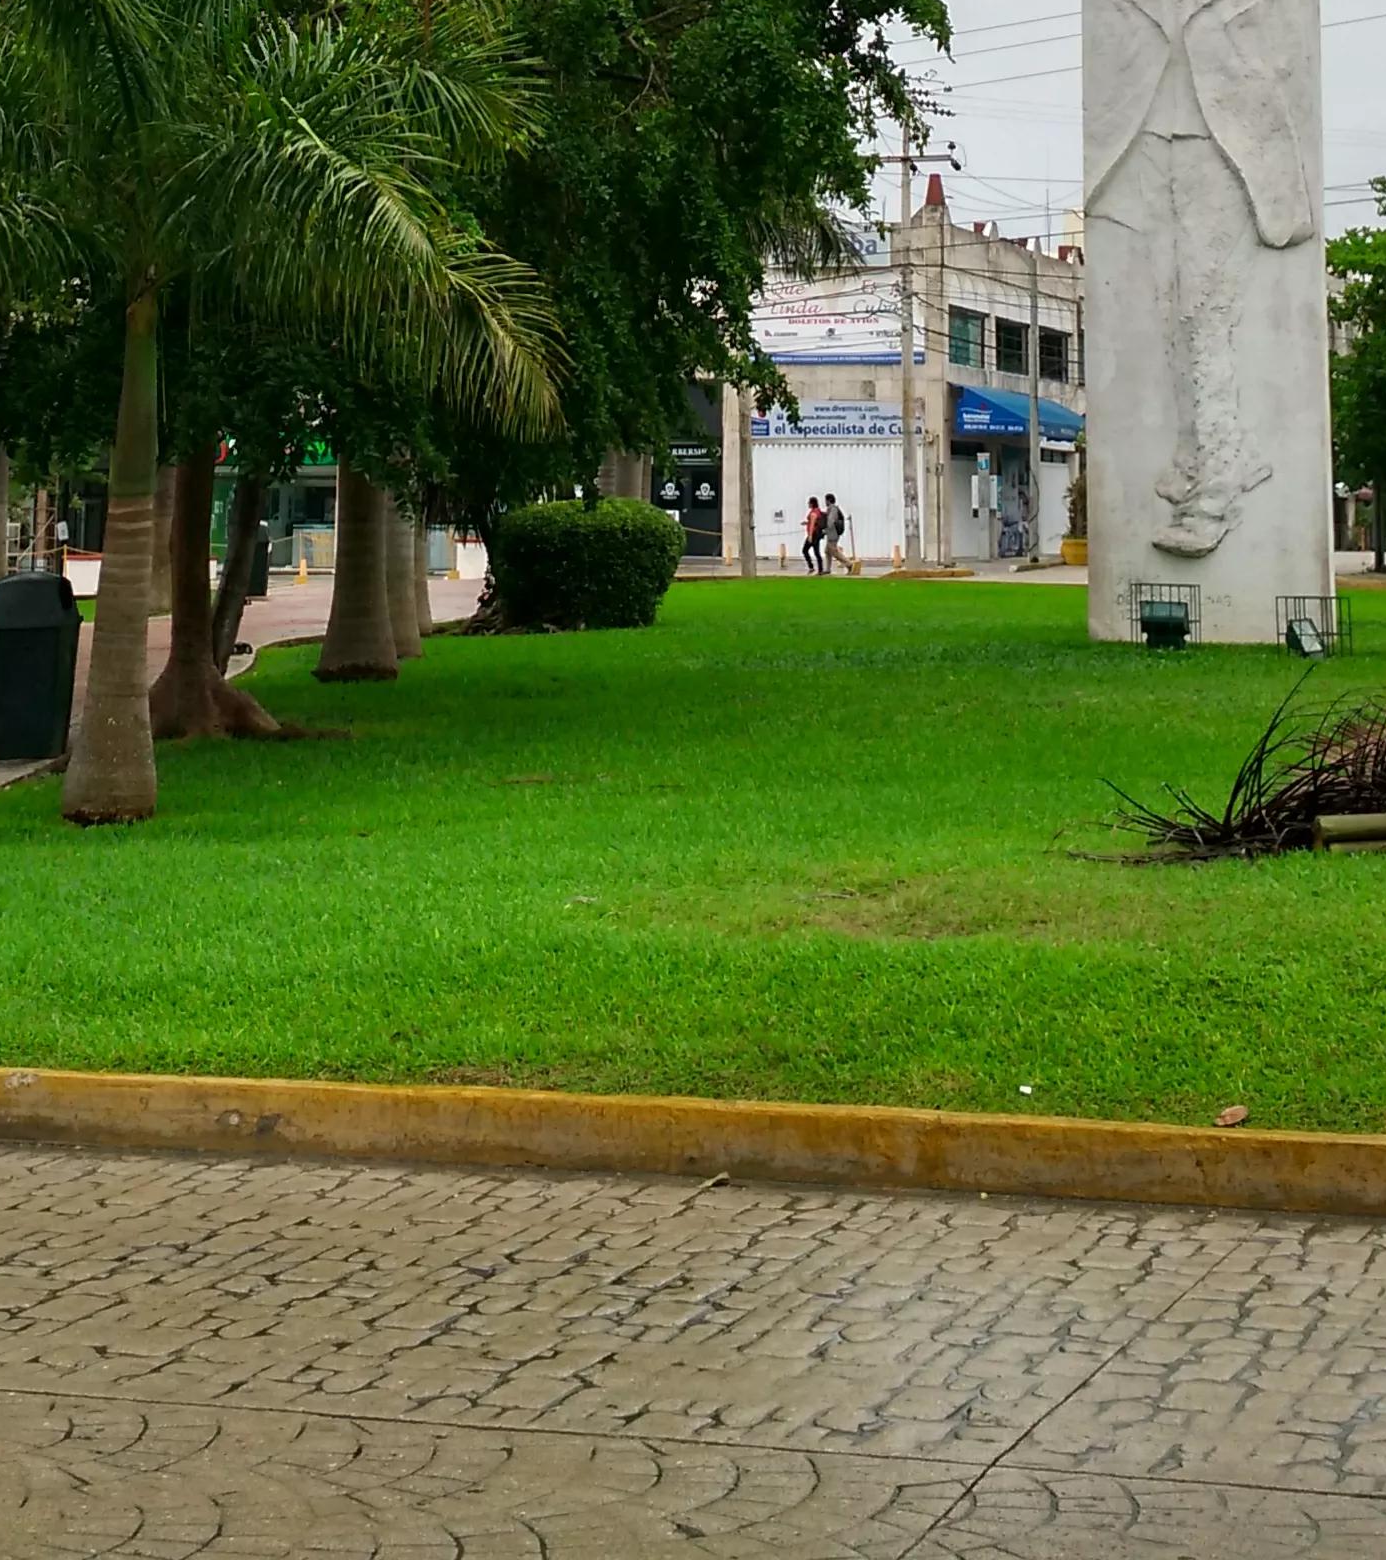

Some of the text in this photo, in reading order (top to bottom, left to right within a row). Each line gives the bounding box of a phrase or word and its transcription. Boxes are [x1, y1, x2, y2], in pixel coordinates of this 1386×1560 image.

[775, 423, 786, 435] el
[789, 423, 864, 438] epecialista
[868, 423, 885, 435] de
[888, 423, 923, 436] Cua
